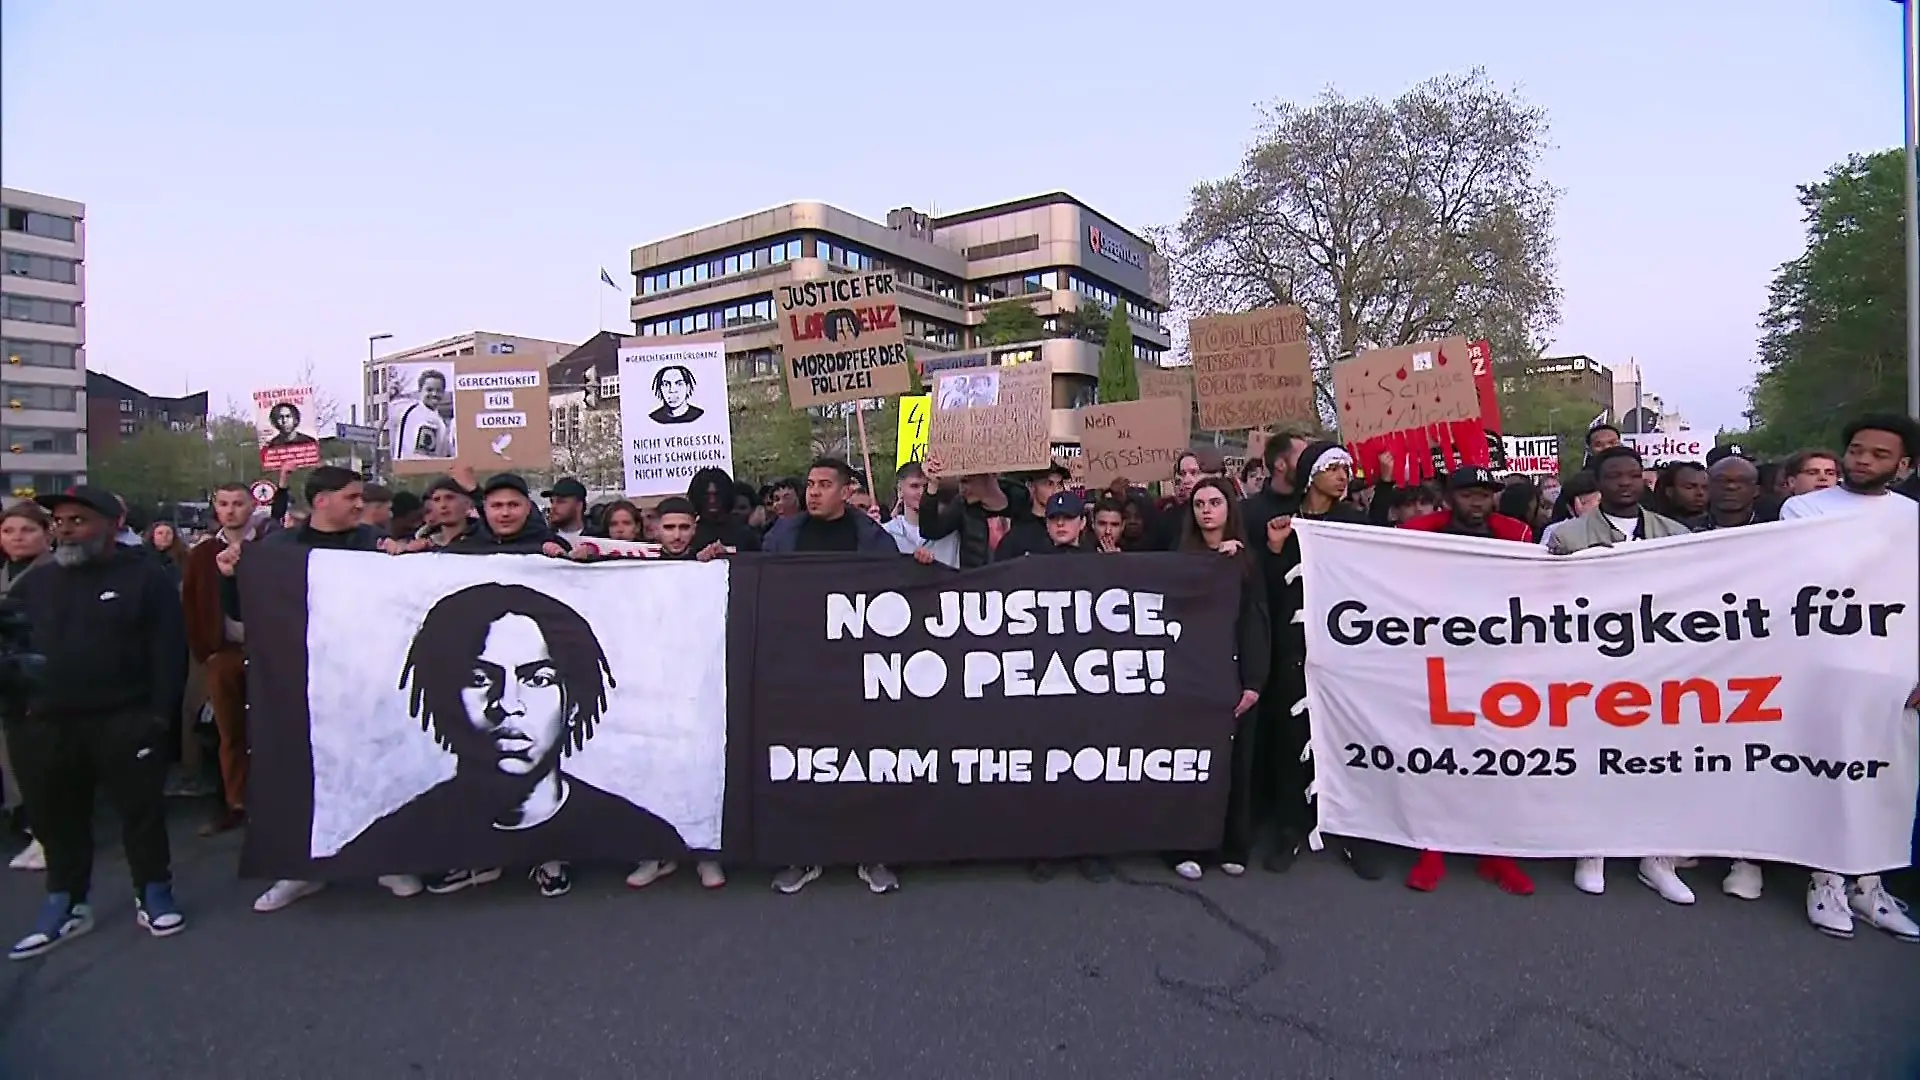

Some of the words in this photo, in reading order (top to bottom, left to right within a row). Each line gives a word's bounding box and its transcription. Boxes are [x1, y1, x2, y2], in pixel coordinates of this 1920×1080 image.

[780, 278, 861, 310] JUSTICE
[864, 274, 895, 296] FOR
[1191, 313, 1306, 352] TÖDLICHER
[792, 346, 877, 379] MORDOPFER
[878, 343, 906, 366] DER
[458, 376, 537, 388] GERECHTIGKEIT
[811, 371, 872, 396] POLIZEI
[489, 394, 510, 406] FÜR
[482, 415, 522, 426] LORENZ
[908, 403, 924, 438] 4
[1085, 413, 1116, 429] Nein
[633, 438, 661, 450] NICHT
[634, 453, 661, 464] NICHT
[1516, 440, 1558, 456] HATTE
[1623, 437, 1700, 456] Justice
[635, 468, 662, 480] NICHT
[826, 591, 912, 639] NO
[924, 588, 1182, 643] JUSTICE,
[1327, 594, 1770, 658] Gerechtigkeit
[1791, 586, 1905, 638] für
[863, 649, 948, 699] NO
[964, 649, 1166, 699] PEACE!
[1426, 657, 1782, 728] Lorenz
[769, 745, 938, 783] DISARM
[951, 748, 1032, 784] THE
[1045, 747, 1212, 783] POLICE!
[1344, 743, 1577, 776] 20.04.2025
[1599, 748, 1682, 775] Rest
[1694, 746, 1731, 773] in
[1744, 743, 1890, 781] Power
